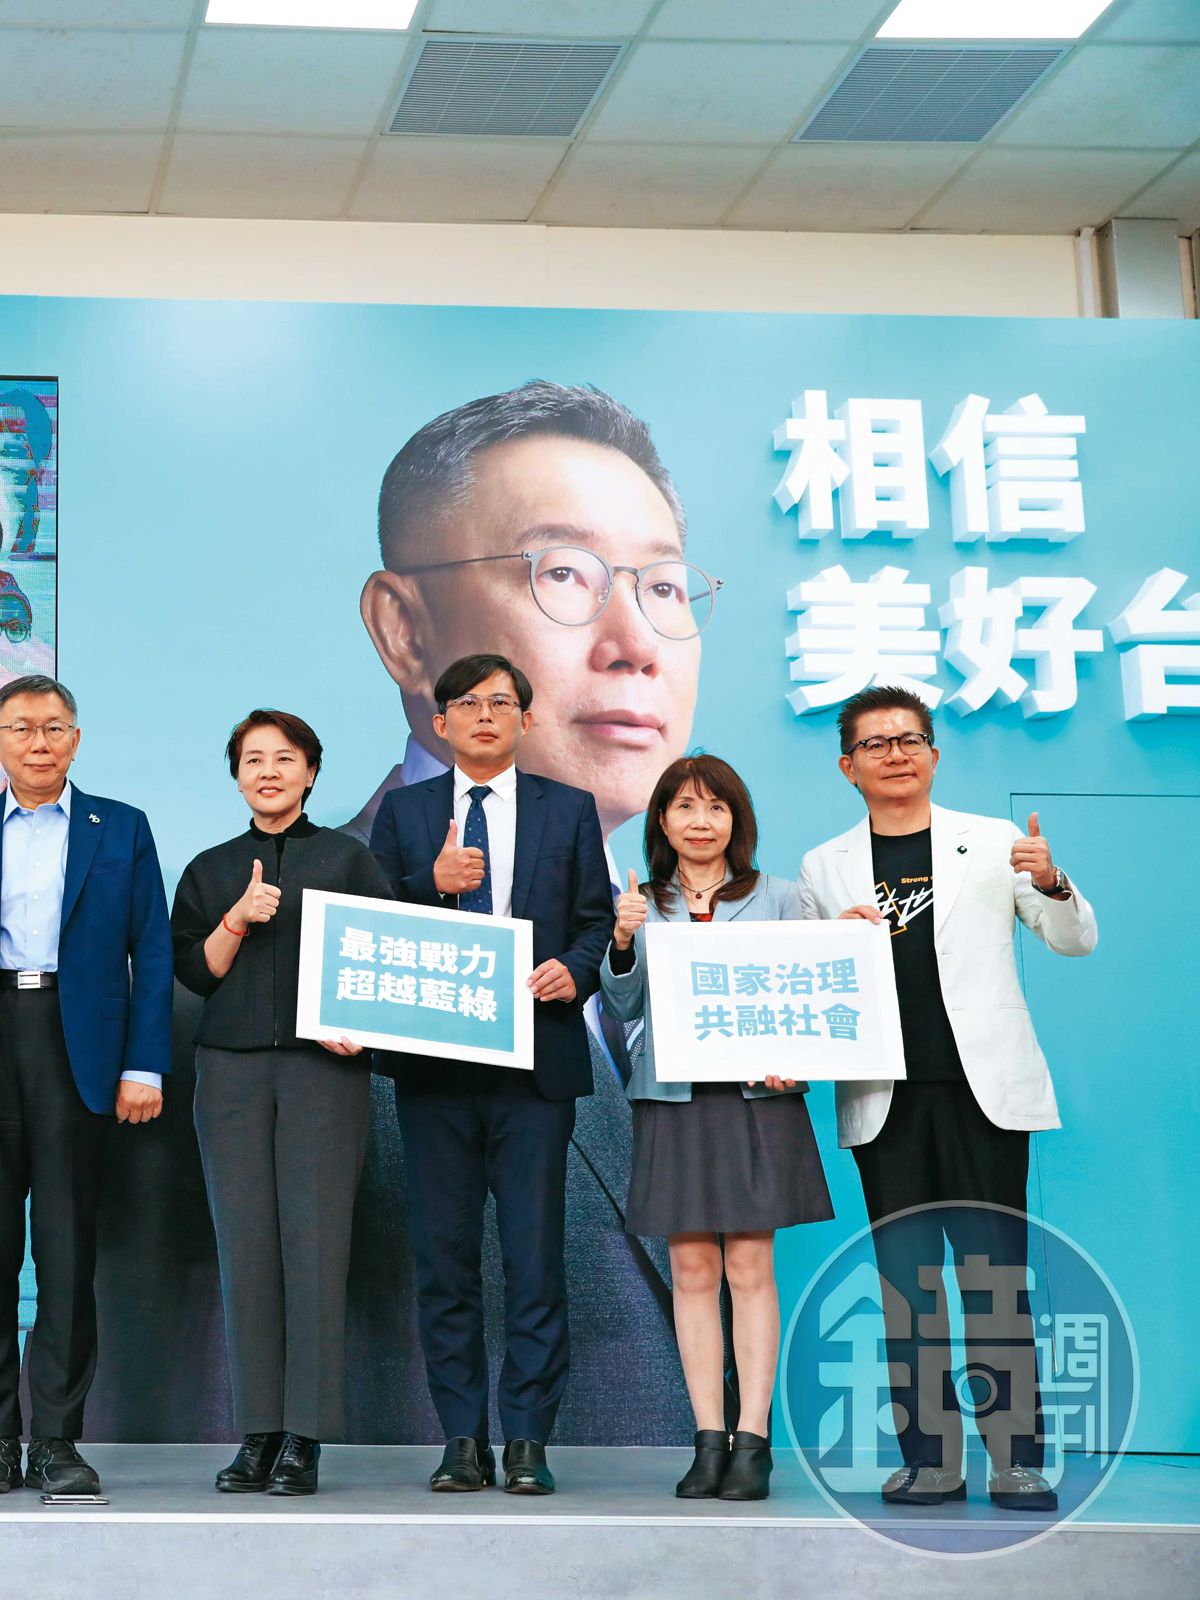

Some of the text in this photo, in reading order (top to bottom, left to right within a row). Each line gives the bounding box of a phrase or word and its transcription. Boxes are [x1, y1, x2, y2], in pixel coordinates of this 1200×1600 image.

[774, 389, 1086, 542] 相信
[900, 876, 929, 884] Strong
[338, 926, 497, 979] 最強戰力
[336, 967, 498, 1022] 超越藍綠
[690, 957, 860, 997] 國家治理
[694, 1003, 862, 1041] 共融社會
